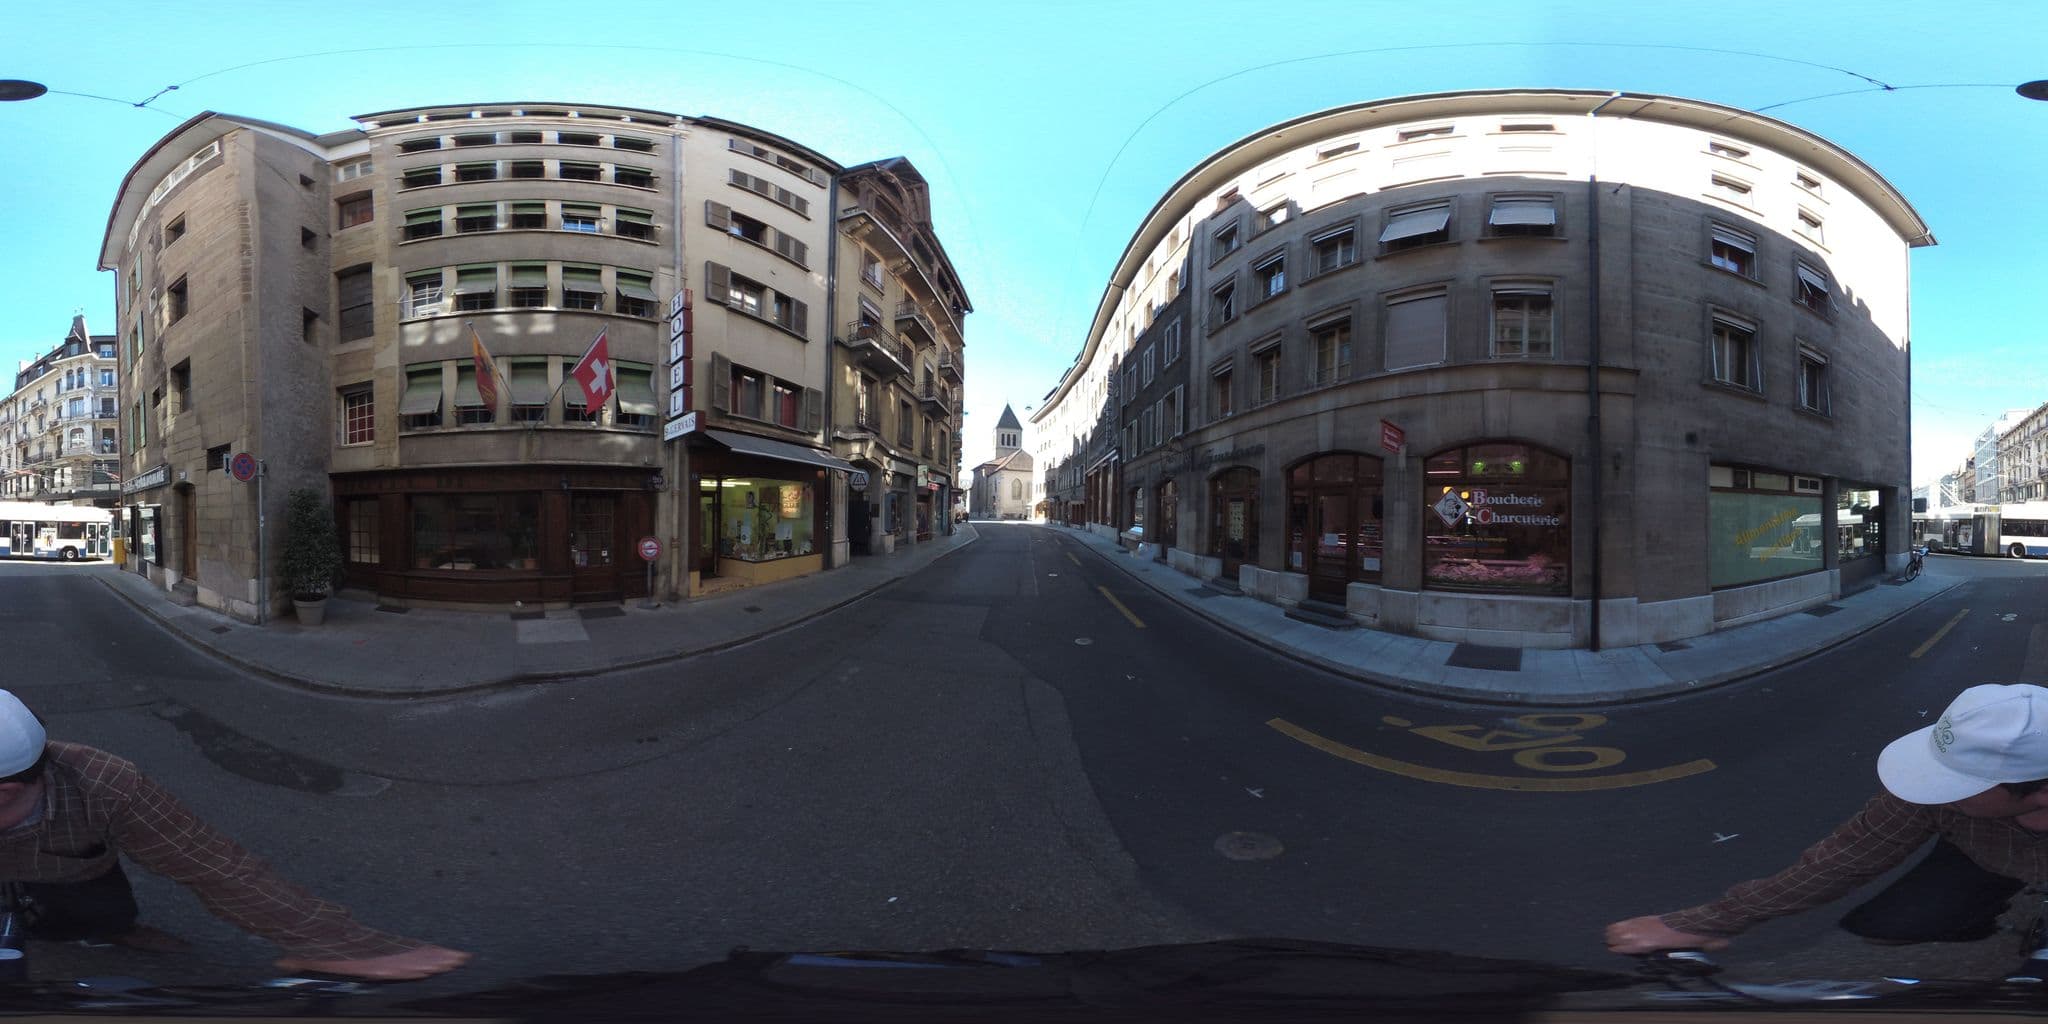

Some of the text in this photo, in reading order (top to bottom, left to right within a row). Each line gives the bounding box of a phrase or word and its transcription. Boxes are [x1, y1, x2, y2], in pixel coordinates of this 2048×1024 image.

[672, 294, 682, 412] HOTEL
[1473, 491, 1542, 506] Boucherie
[1477, 509, 1560, 526] Charcuterie
